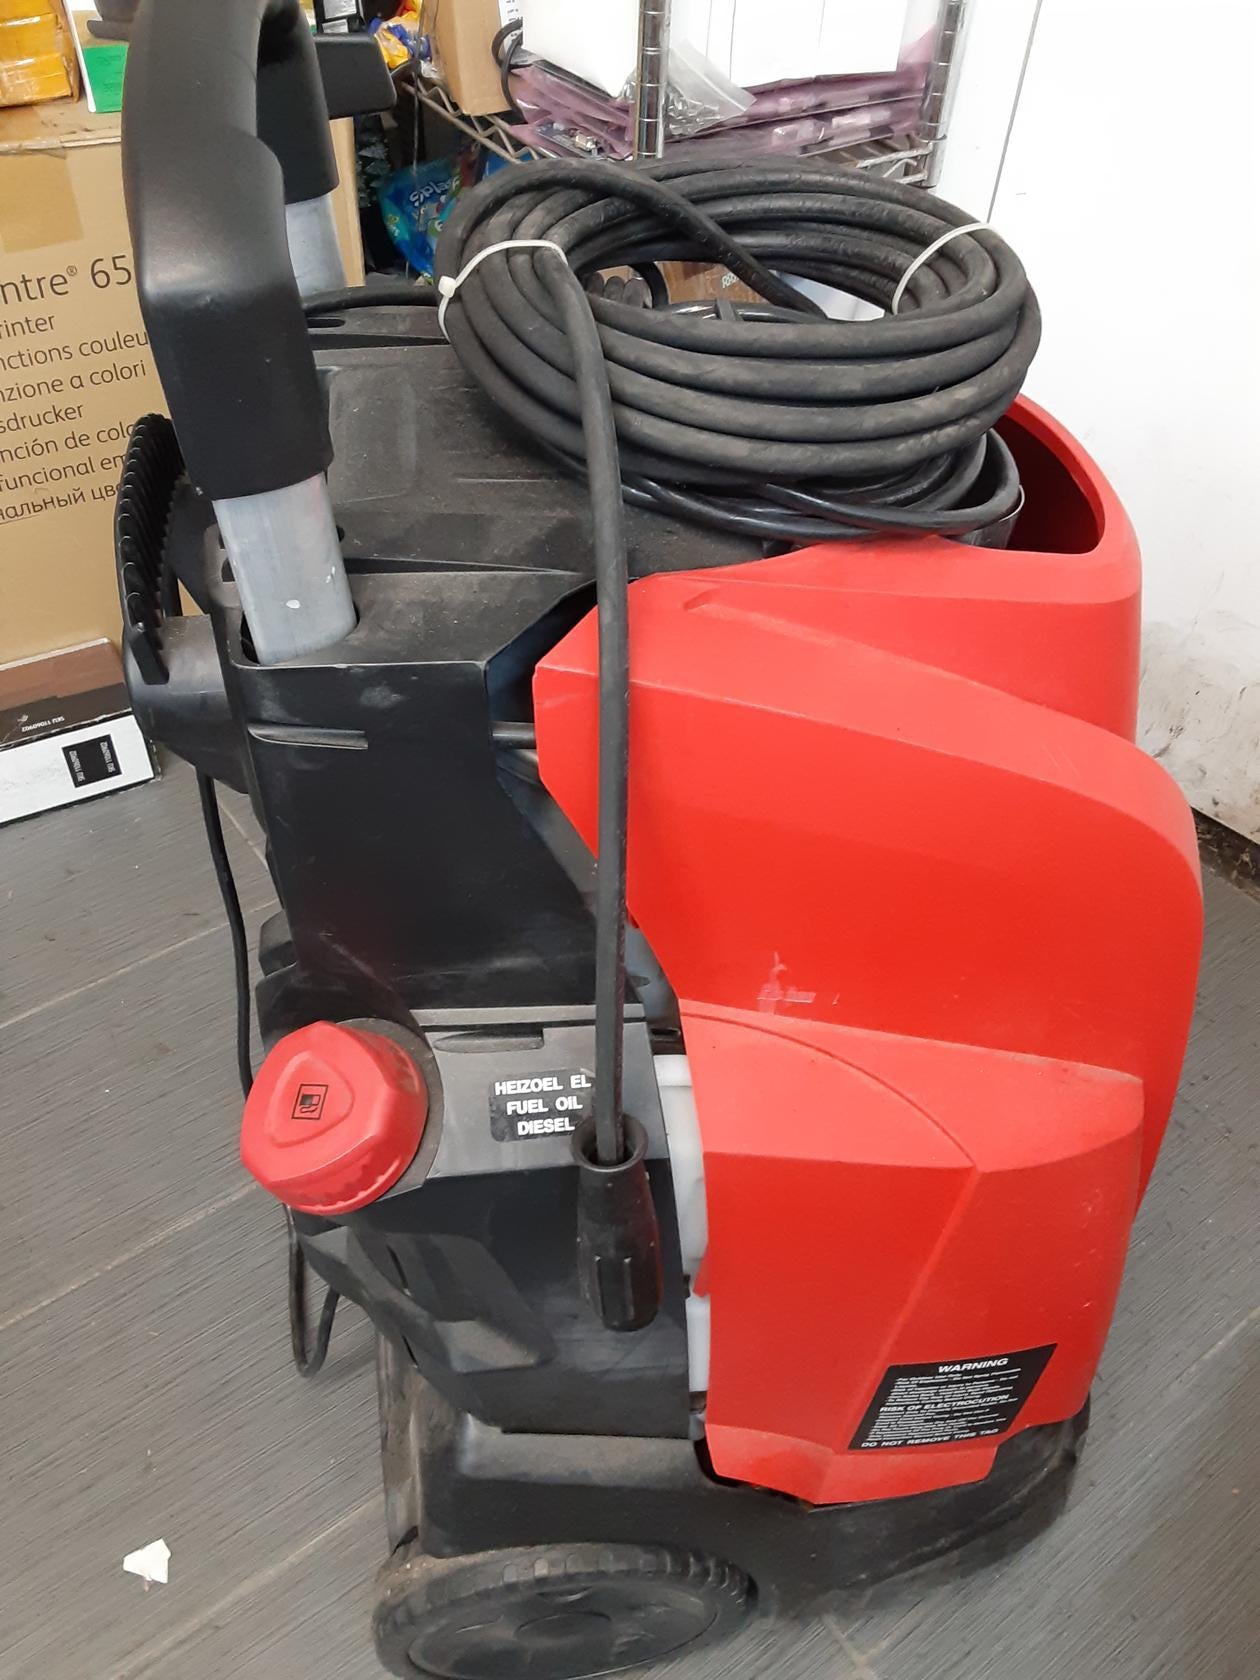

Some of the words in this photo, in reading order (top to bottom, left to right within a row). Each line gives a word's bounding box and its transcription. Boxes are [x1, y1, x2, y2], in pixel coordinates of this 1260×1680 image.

[90, 254, 132, 289] 65
[70, 375, 85, 390] a
[89, 360, 146, 386] colori
[0, 404, 83, 434] sdrucker
[0, 438, 59, 463] nción
[64, 431, 91, 449] de
[495, 1077, 564, 1096] HEIZOEL
[570, 1074, 592, 1089] EL
[506, 1099, 549, 1115] FUEL
[555, 1096, 583, 1111] OIL
[517, 1117, 575, 1136] DIESEL
[938, 1357, 1009, 1373] WARNING
[879, 1404, 905, 1412] RISK
[907, 1403, 922, 1411] OF
[924, 1394, 1010, 1410] ELECTROCUTION
[906, 1435, 950, 1445] REMOVE
